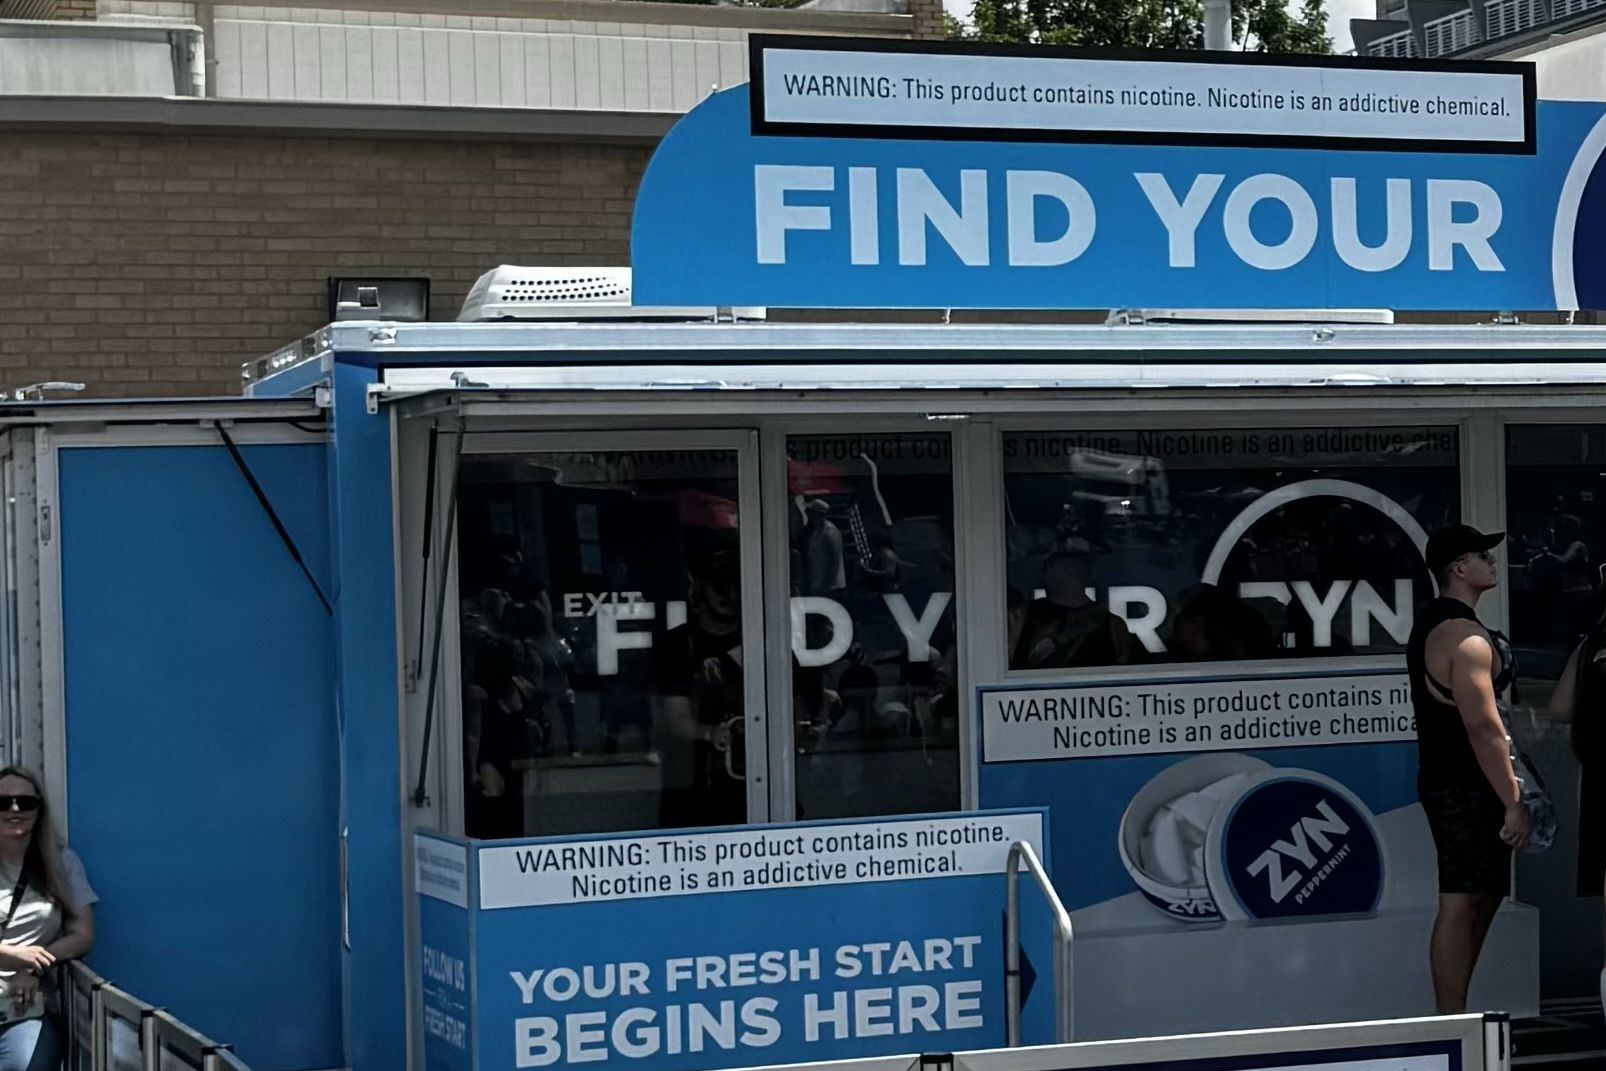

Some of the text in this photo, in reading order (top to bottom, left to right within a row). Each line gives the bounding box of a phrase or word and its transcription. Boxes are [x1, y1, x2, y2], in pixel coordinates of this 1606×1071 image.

[784, 73, 1511, 117] WARNING: This product contains nicotine. Nicotine is an addictive chemical.
[754, 164, 1506, 273] FIND YOUR
[1136, 430, 1233, 456] Nicotine
[1240, 430, 1260, 454] is
[1267, 433, 1295, 454] an
[1302, 427, 1400, 453] addictive
[563, 591, 643, 618] EXIT
[596, 585, 1168, 676] FD YR
[999, 694, 1131, 725] WARNING:
[1137, 691, 1186, 716] This
[1192, 687, 1281, 719] product
[1287, 684, 1383, 710] contains
[1052, 710, 1418, 751] Nicotine is an addictive chemica
[516, 822, 1010, 875] WARNING: This product contains nicotine.
[572, 851, 963, 899] Nicotine is an addictive chemical.
[1246, 799, 1350, 903] ZYN
[1295, 843, 1351, 905] PEPPERMINT
[510, 936, 982, 1004] YOUR FRESH START
[515, 980, 984, 1069] BEGINS HERE
